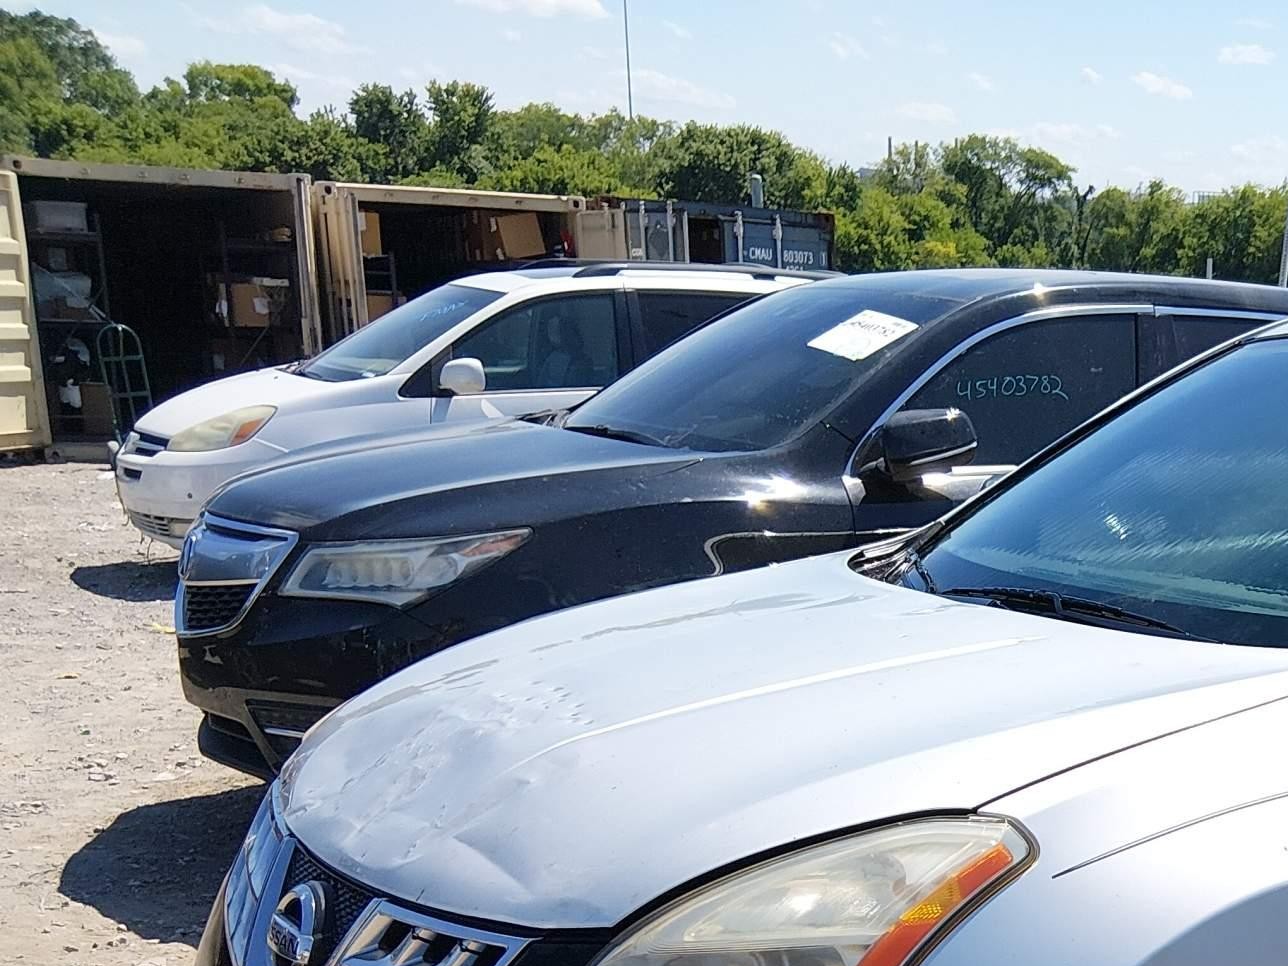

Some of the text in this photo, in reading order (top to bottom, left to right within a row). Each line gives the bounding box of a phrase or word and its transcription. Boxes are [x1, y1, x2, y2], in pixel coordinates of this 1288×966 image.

[749, 247, 773, 261] CMAU
[783, 250, 814, 265] 803073
[957, 375, 1069, 400] 45403782
[269, 926, 300, 955] SSAN
